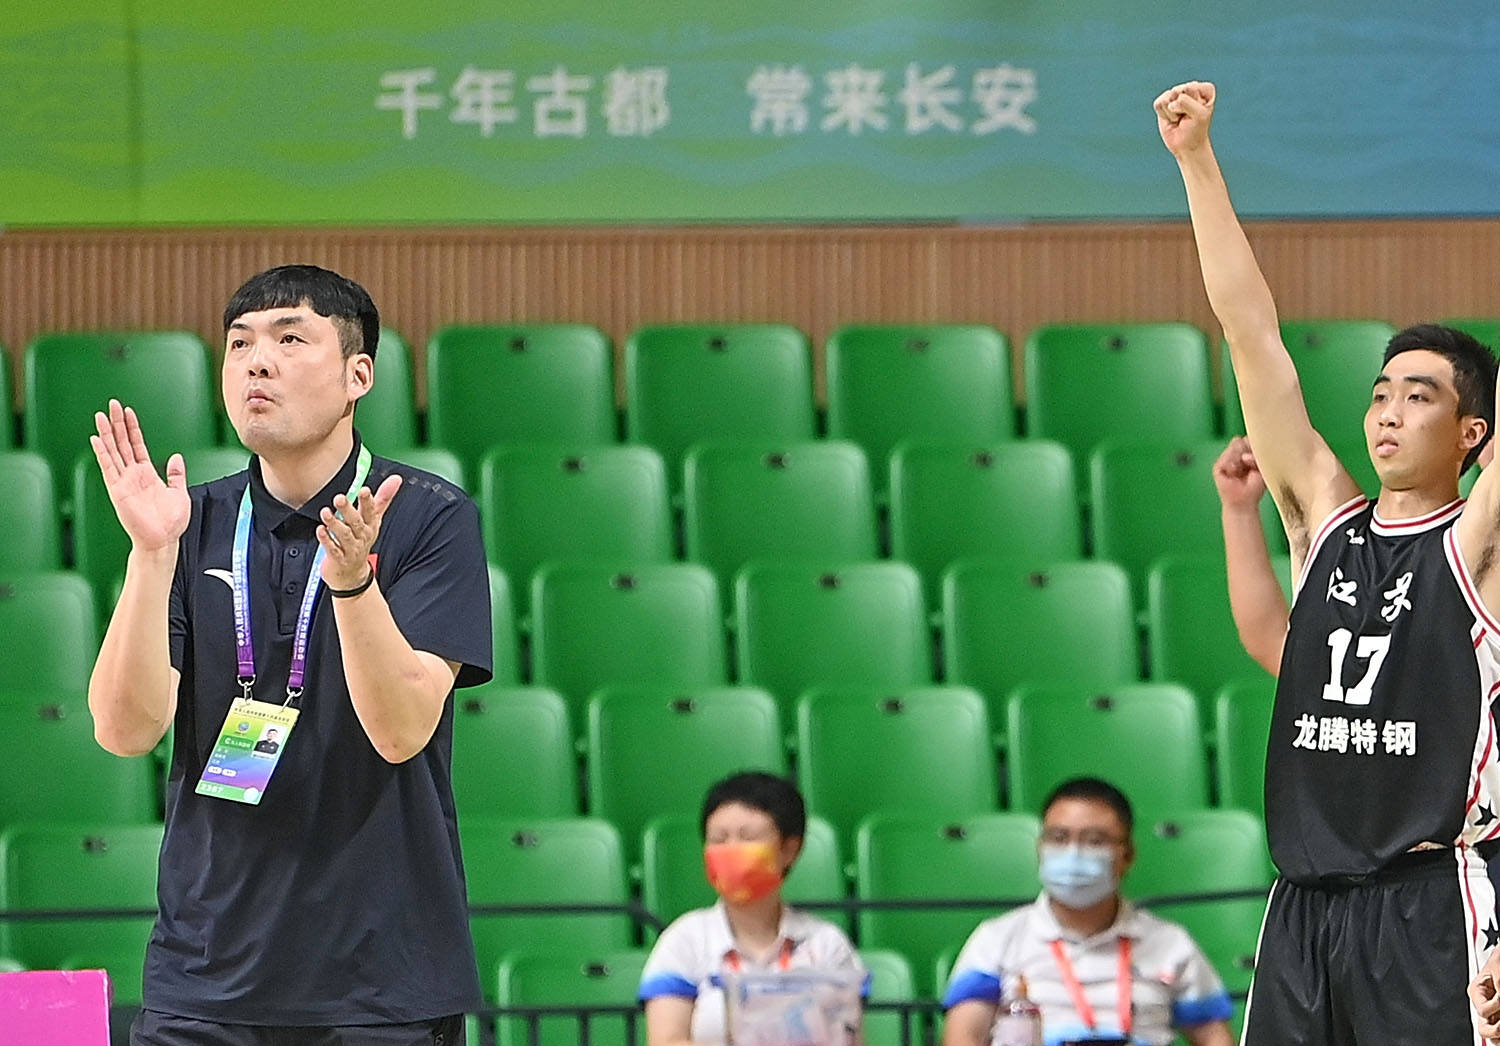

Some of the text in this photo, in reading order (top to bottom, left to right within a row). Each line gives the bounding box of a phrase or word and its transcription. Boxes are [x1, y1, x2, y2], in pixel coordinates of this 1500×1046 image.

[374, 64, 1038, 139] 千年古都 常来长安
[1322, 627, 1392, 705] 17
[1292, 713, 1417, 756] 龙腾特钢
